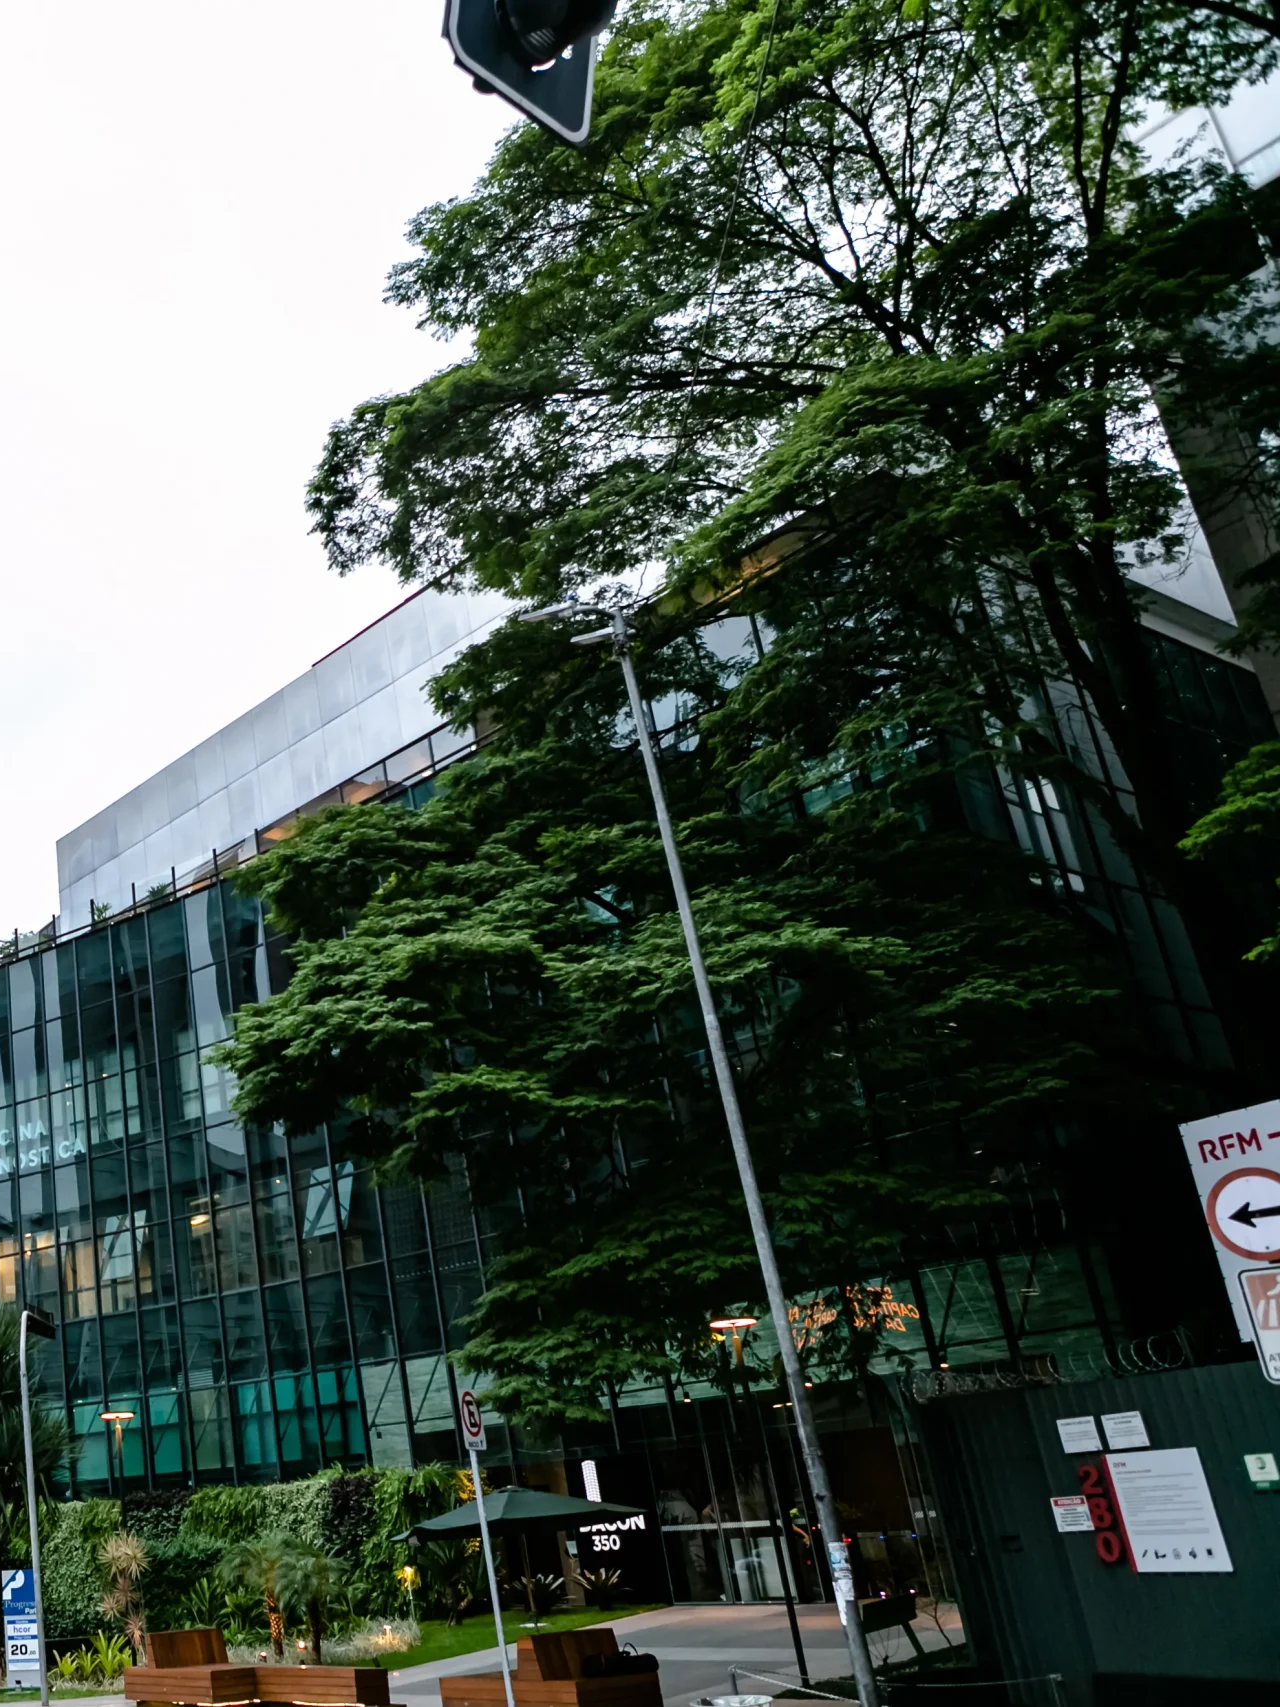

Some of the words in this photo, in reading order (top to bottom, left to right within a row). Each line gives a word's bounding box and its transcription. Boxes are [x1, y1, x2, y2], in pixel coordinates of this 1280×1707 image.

[1198, 1128, 1262, 1163] RFM
[591, 1534, 621, 1552] 350
[5, 1600, 35, 1610] Progres
[13, 1625, 31, 1633] hcor
